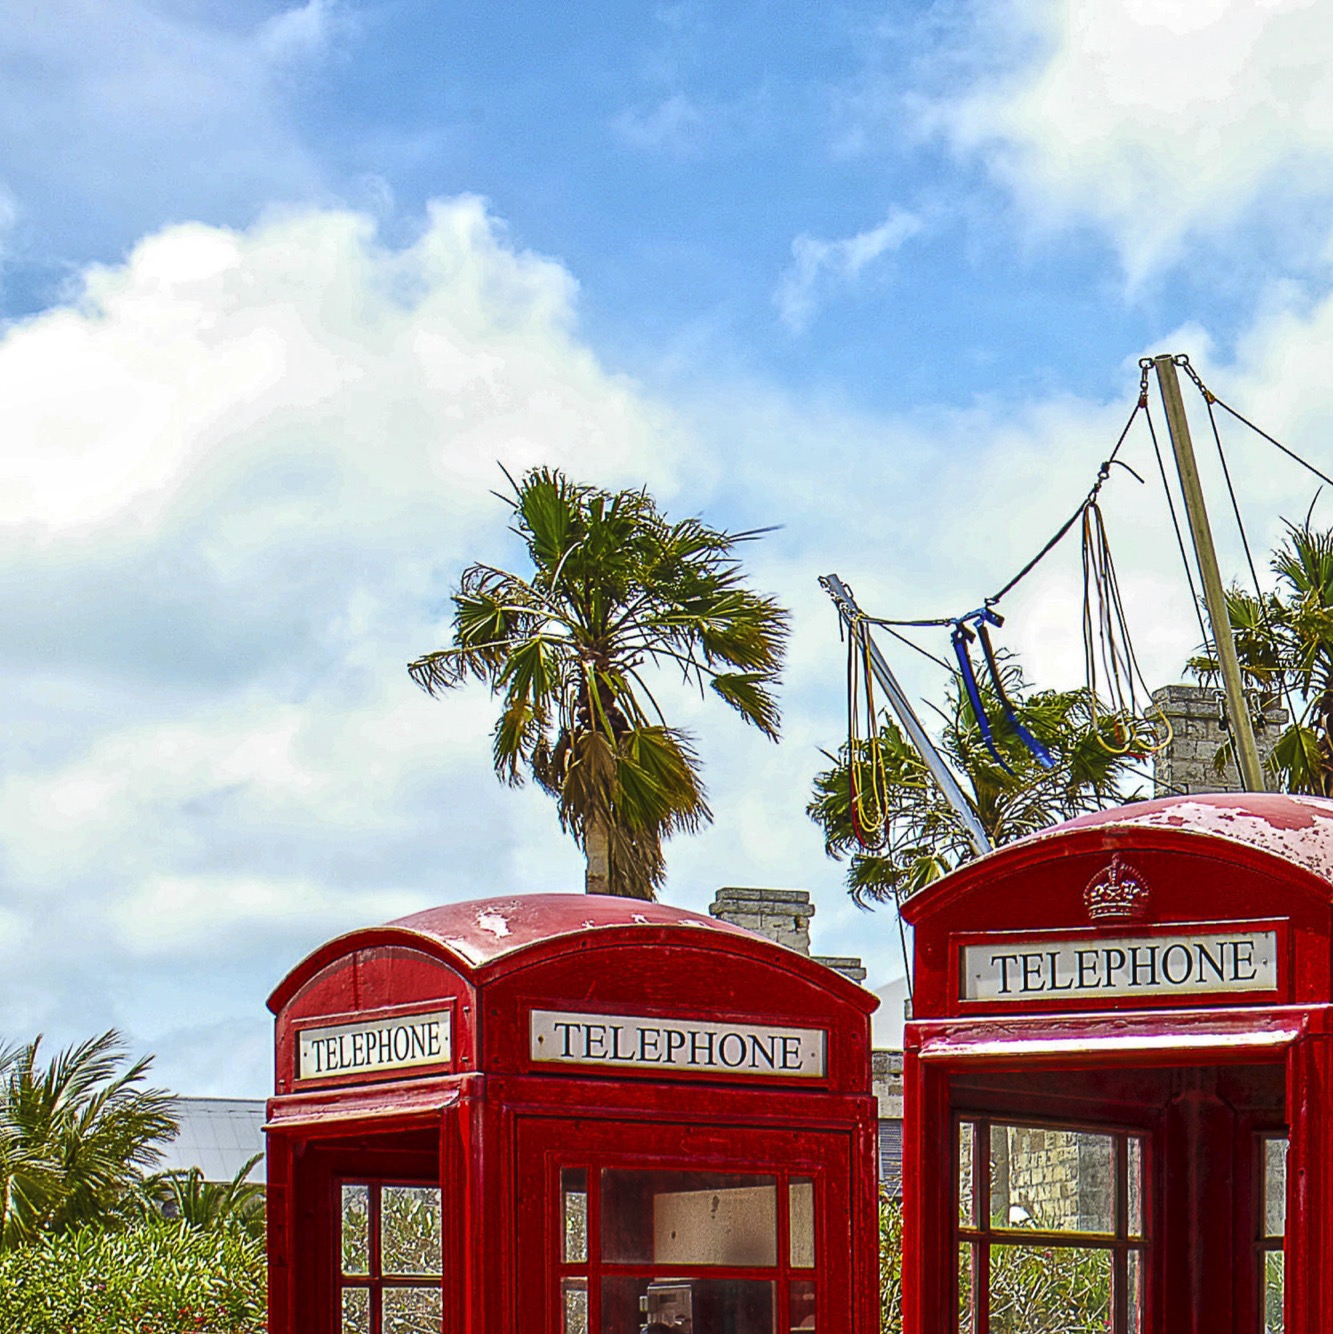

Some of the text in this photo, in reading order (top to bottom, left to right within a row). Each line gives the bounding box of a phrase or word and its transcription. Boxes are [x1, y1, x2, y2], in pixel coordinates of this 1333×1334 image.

[991, 940, 1258, 994] TELEPHONE
[311, 1021, 441, 1073] TELEPHONE
[554, 1022, 803, 1070] TELEPHONE
